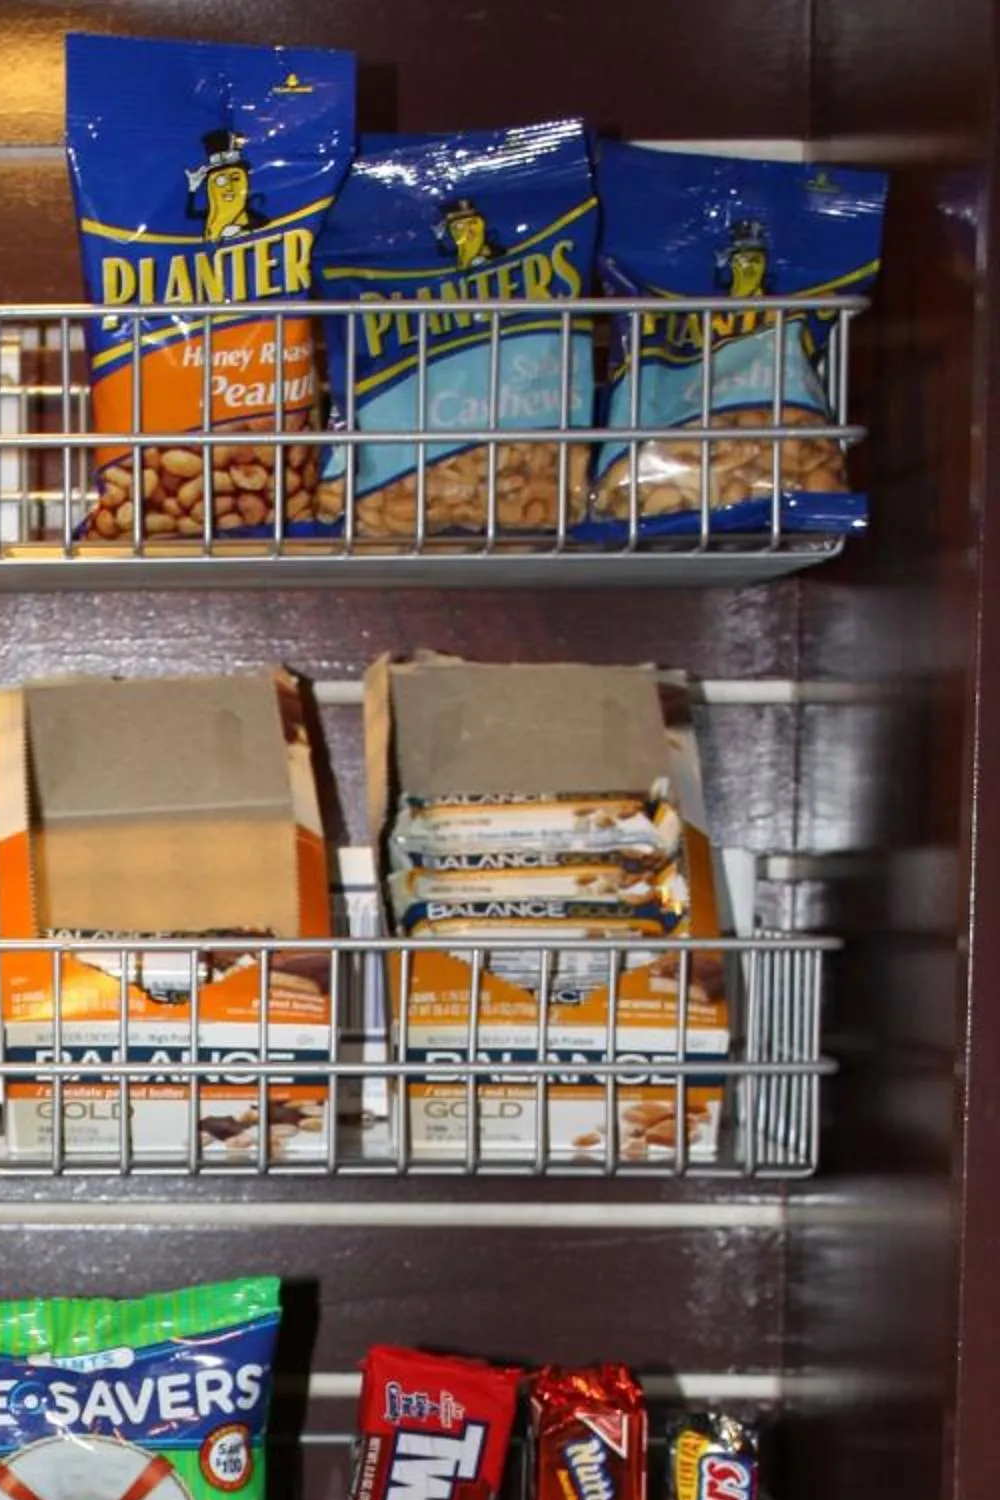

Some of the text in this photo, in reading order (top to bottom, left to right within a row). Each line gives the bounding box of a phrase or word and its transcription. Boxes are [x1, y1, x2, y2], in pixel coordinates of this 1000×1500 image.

[360, 240, 582, 357] PLANTERS
[183, 344, 254, 372] Hney
[199, 375, 313, 408] Peanu
[427, 902, 567, 920] BALANCE
[36, 1101, 135, 1121] GOLD
[48, 1363, 263, 1426] SAVERS
